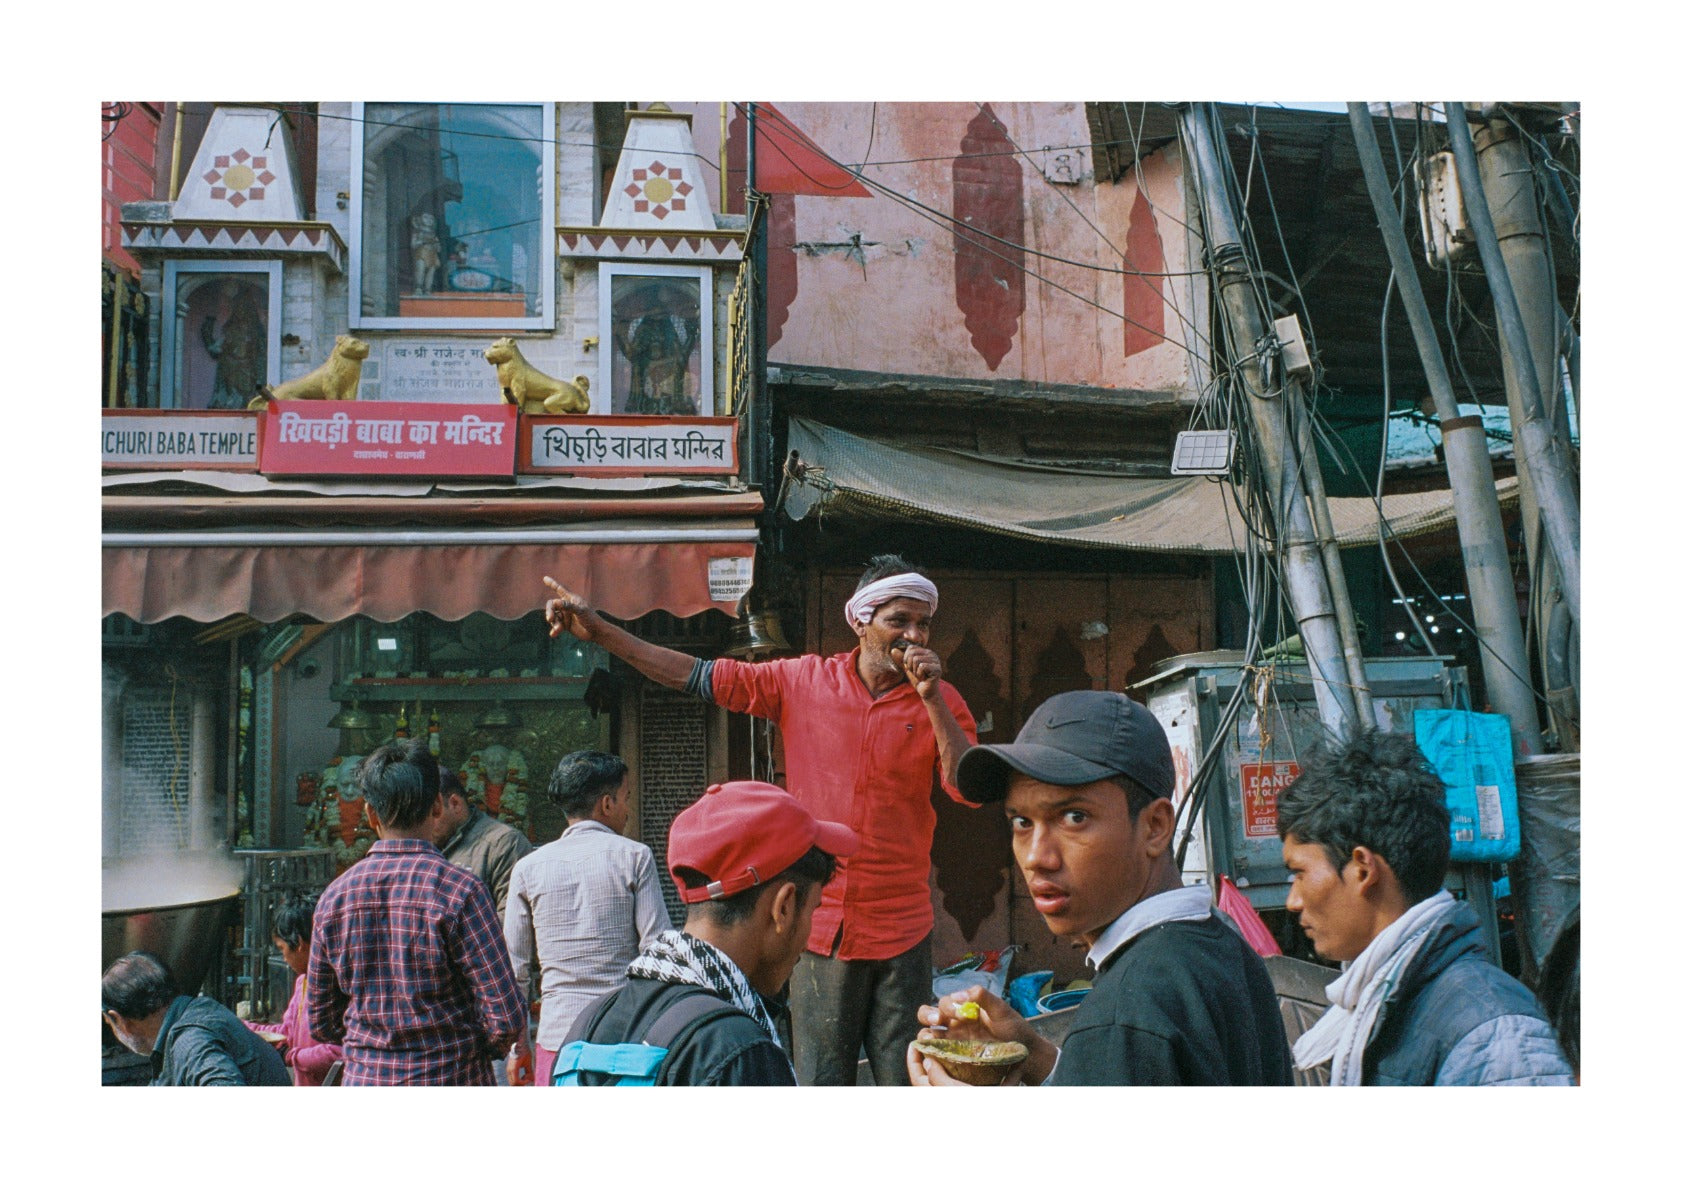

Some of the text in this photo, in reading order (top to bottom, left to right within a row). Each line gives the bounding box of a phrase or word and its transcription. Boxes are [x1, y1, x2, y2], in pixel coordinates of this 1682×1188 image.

[156, 431, 196, 455] BABA
[200, 432, 256, 455] TEMPLE
[279, 412, 505, 450] खिचड़ी बाबा का मन्दिर
[543, 427, 726, 463] খিচুড়ি বাবার মন্দির
[1250, 775, 1294, 788] DANG
